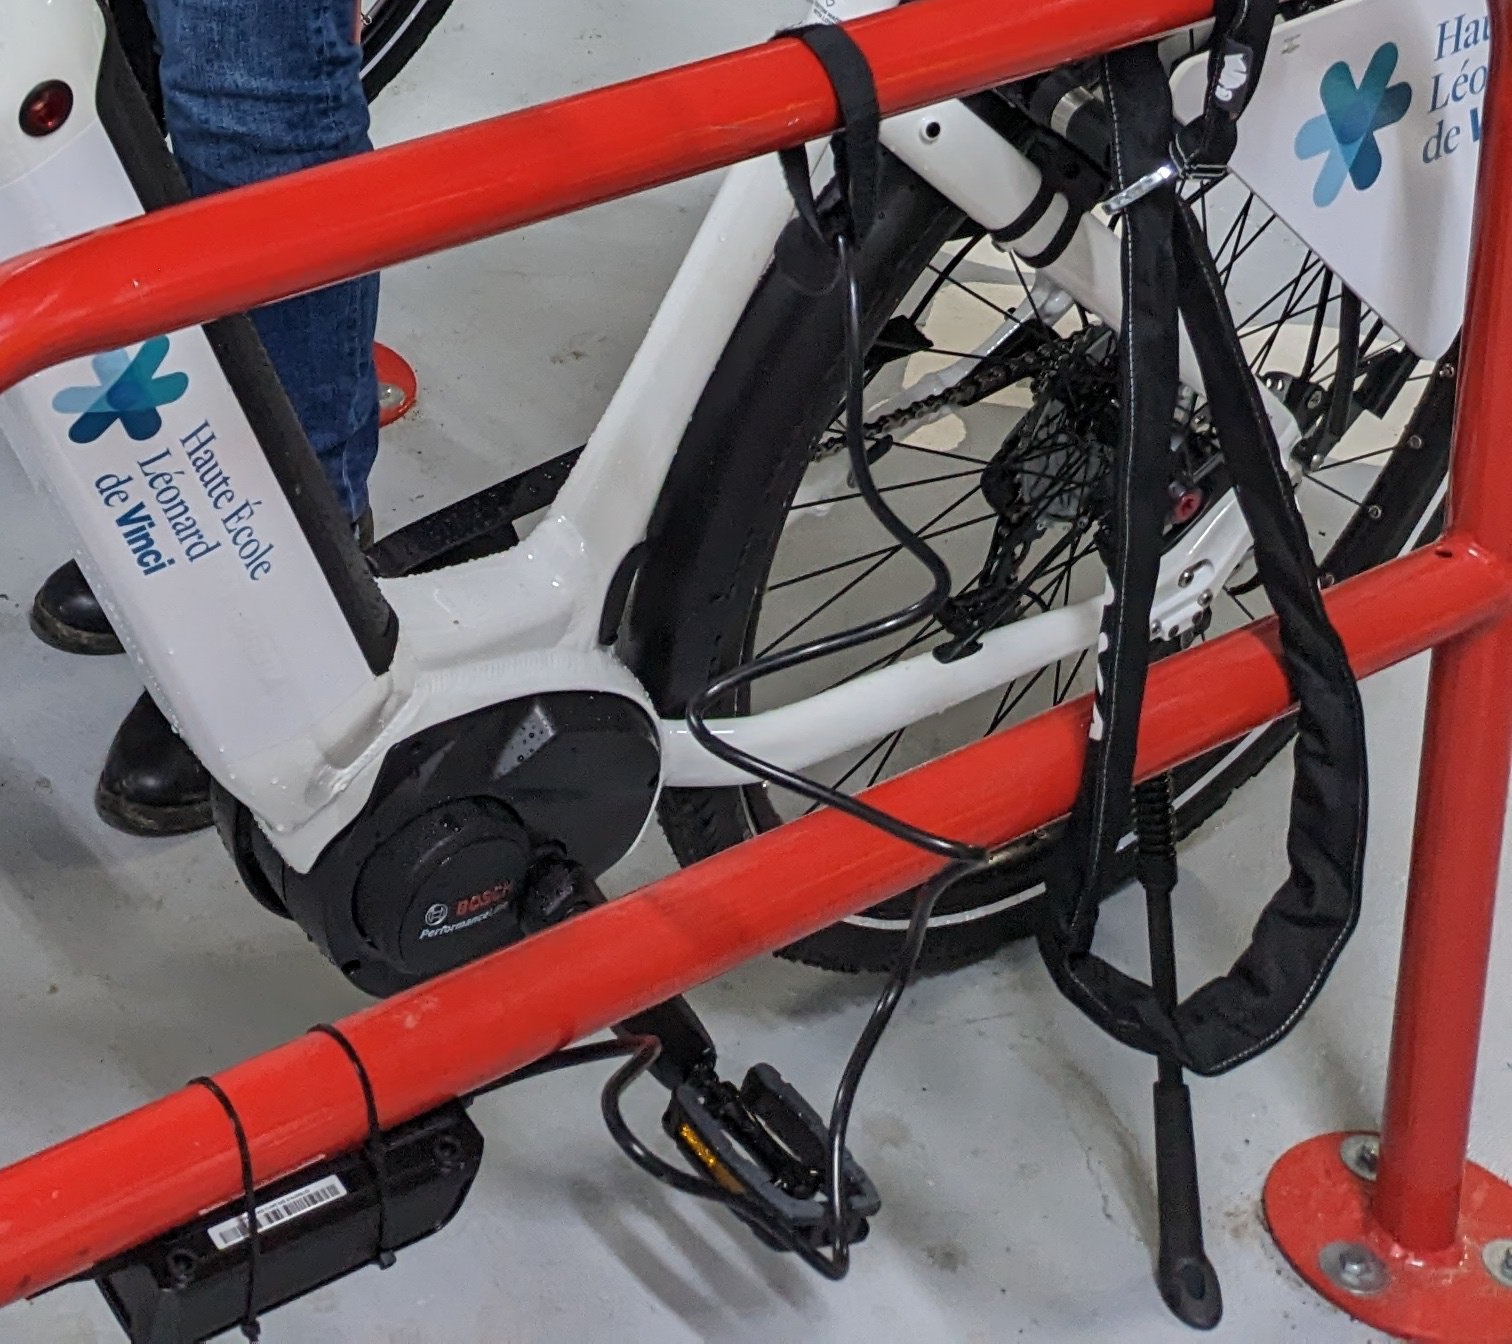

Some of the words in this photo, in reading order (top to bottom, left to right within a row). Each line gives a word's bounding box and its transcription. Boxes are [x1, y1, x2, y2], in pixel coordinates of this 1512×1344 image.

[1428, 58, 1488, 114] Léo
[1422, 119, 1461, 164] de
[94, 473, 135, 507] de
[115, 501, 176, 576] Vinci
[137, 447, 222, 563] Léonard
[179, 418, 236, 510] Haute
[221, 499, 274, 581] École
